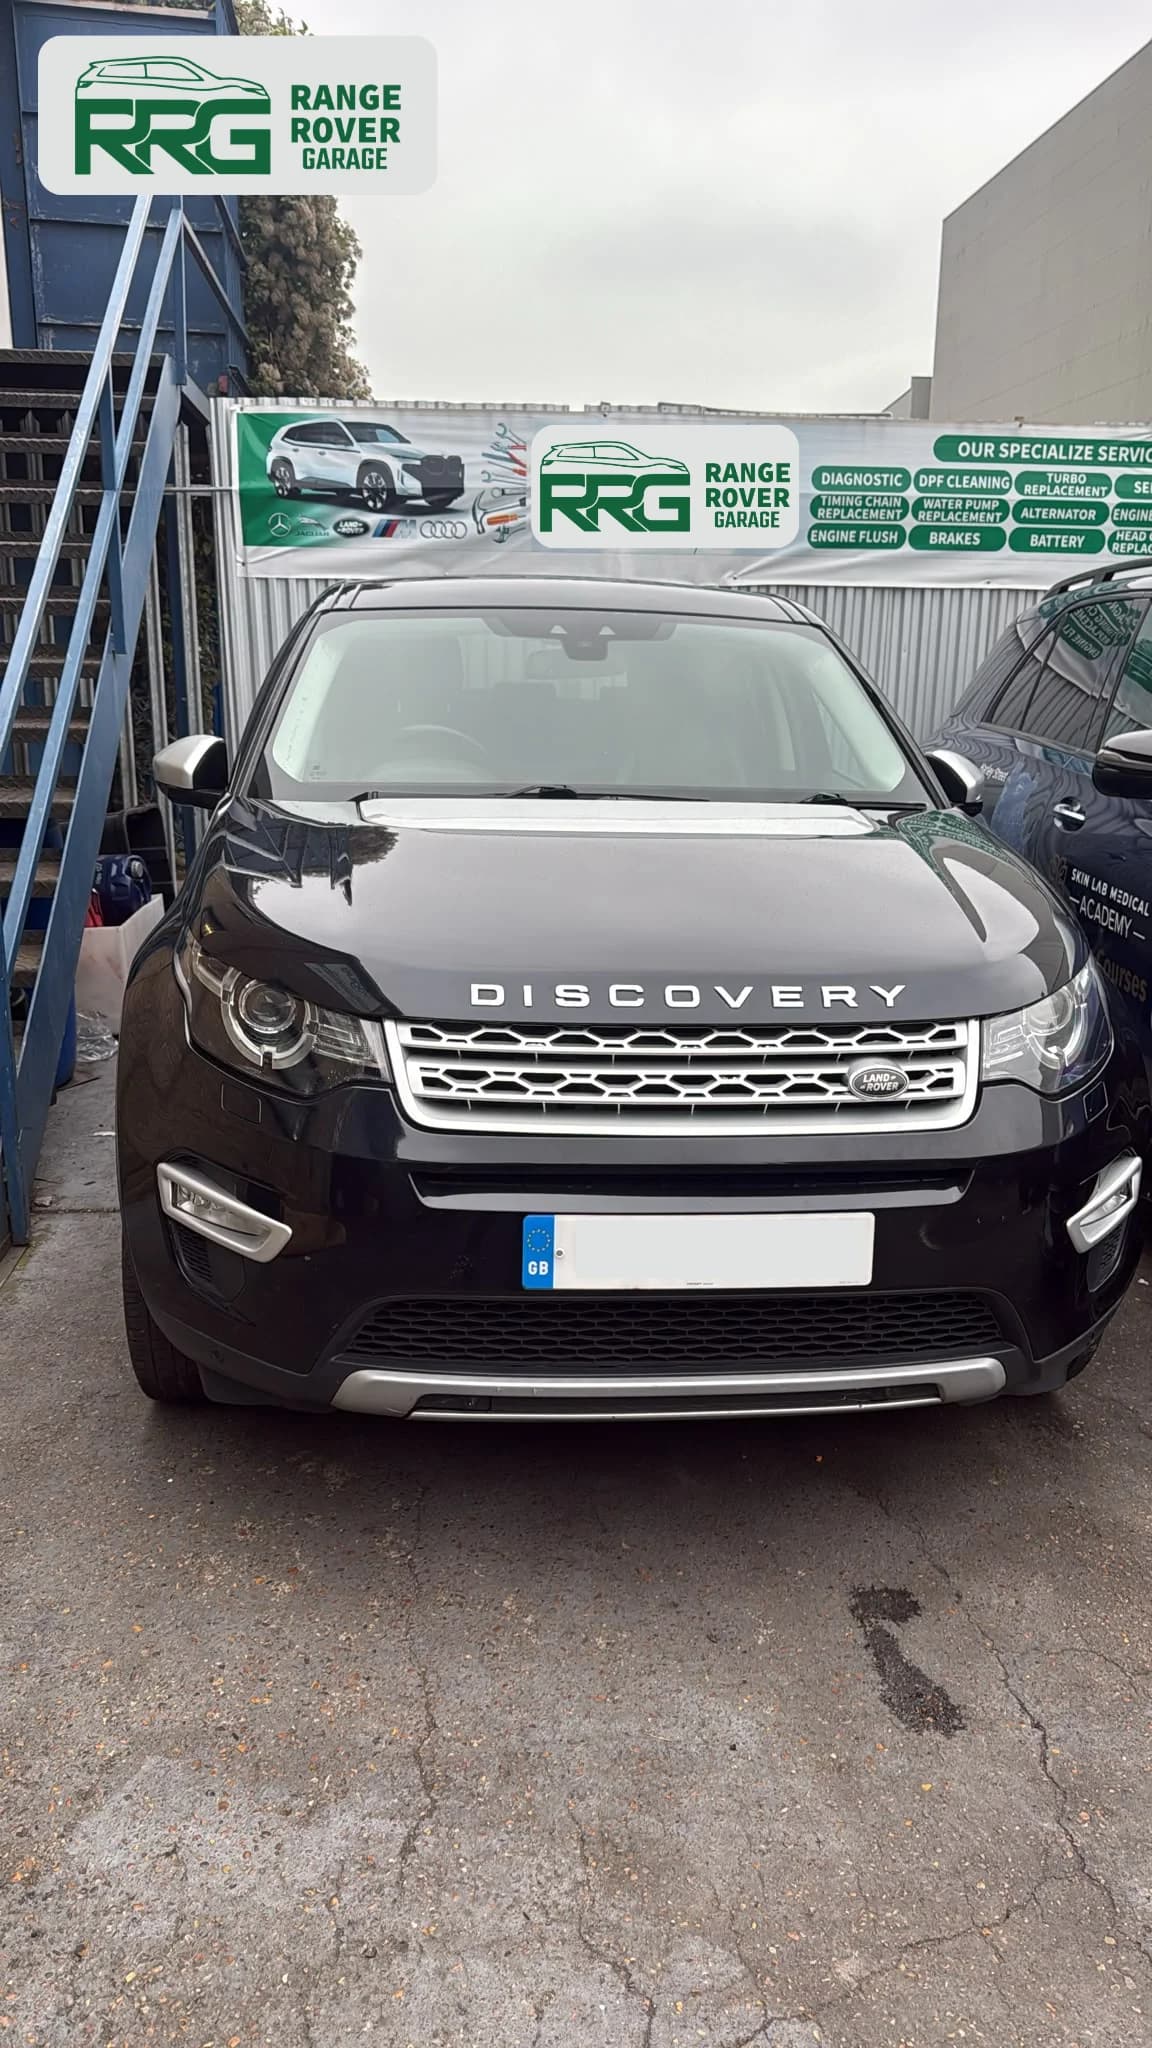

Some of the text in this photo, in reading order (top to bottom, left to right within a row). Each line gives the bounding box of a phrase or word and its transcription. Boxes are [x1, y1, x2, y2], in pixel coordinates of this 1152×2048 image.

[958, 441, 995, 458] OUR
[999, 442, 1094, 461] SPECIALIZE
[821, 472, 903, 487] DIAGNOSTIC
[919, 474, 1010, 489] DPF CLEANING
[1046, 472, 1087, 484] TURBO
[1023, 484, 1108, 497] REPLACEMENT
[821, 495, 902, 508] TIMING CHAIN
[923, 498, 1000, 511] WATER PUMP
[817, 507, 903, 521] REPLACEMENT
[917, 510, 1003, 523] REPLACEMENT
[1020, 507, 1097, 521] ALTERNATOR
[810, 529, 899, 544] ENGINE FLUSH
[929, 531, 981, 546] BRAKES
[1029, 534, 1086, 549] BATTERY
[1116, 530, 1147, 542] HEAD
[1071, 868, 1150, 917] SKIN LAB MEDICAL
[1079, 895, 1133, 939] ACADEMY
[470, 983, 906, 1008] DISCOVERY
[863, 1073, 890, 1083] LAND
[865, 1081, 899, 1092] ROVER
[528, 1260, 549, 1276] GB
